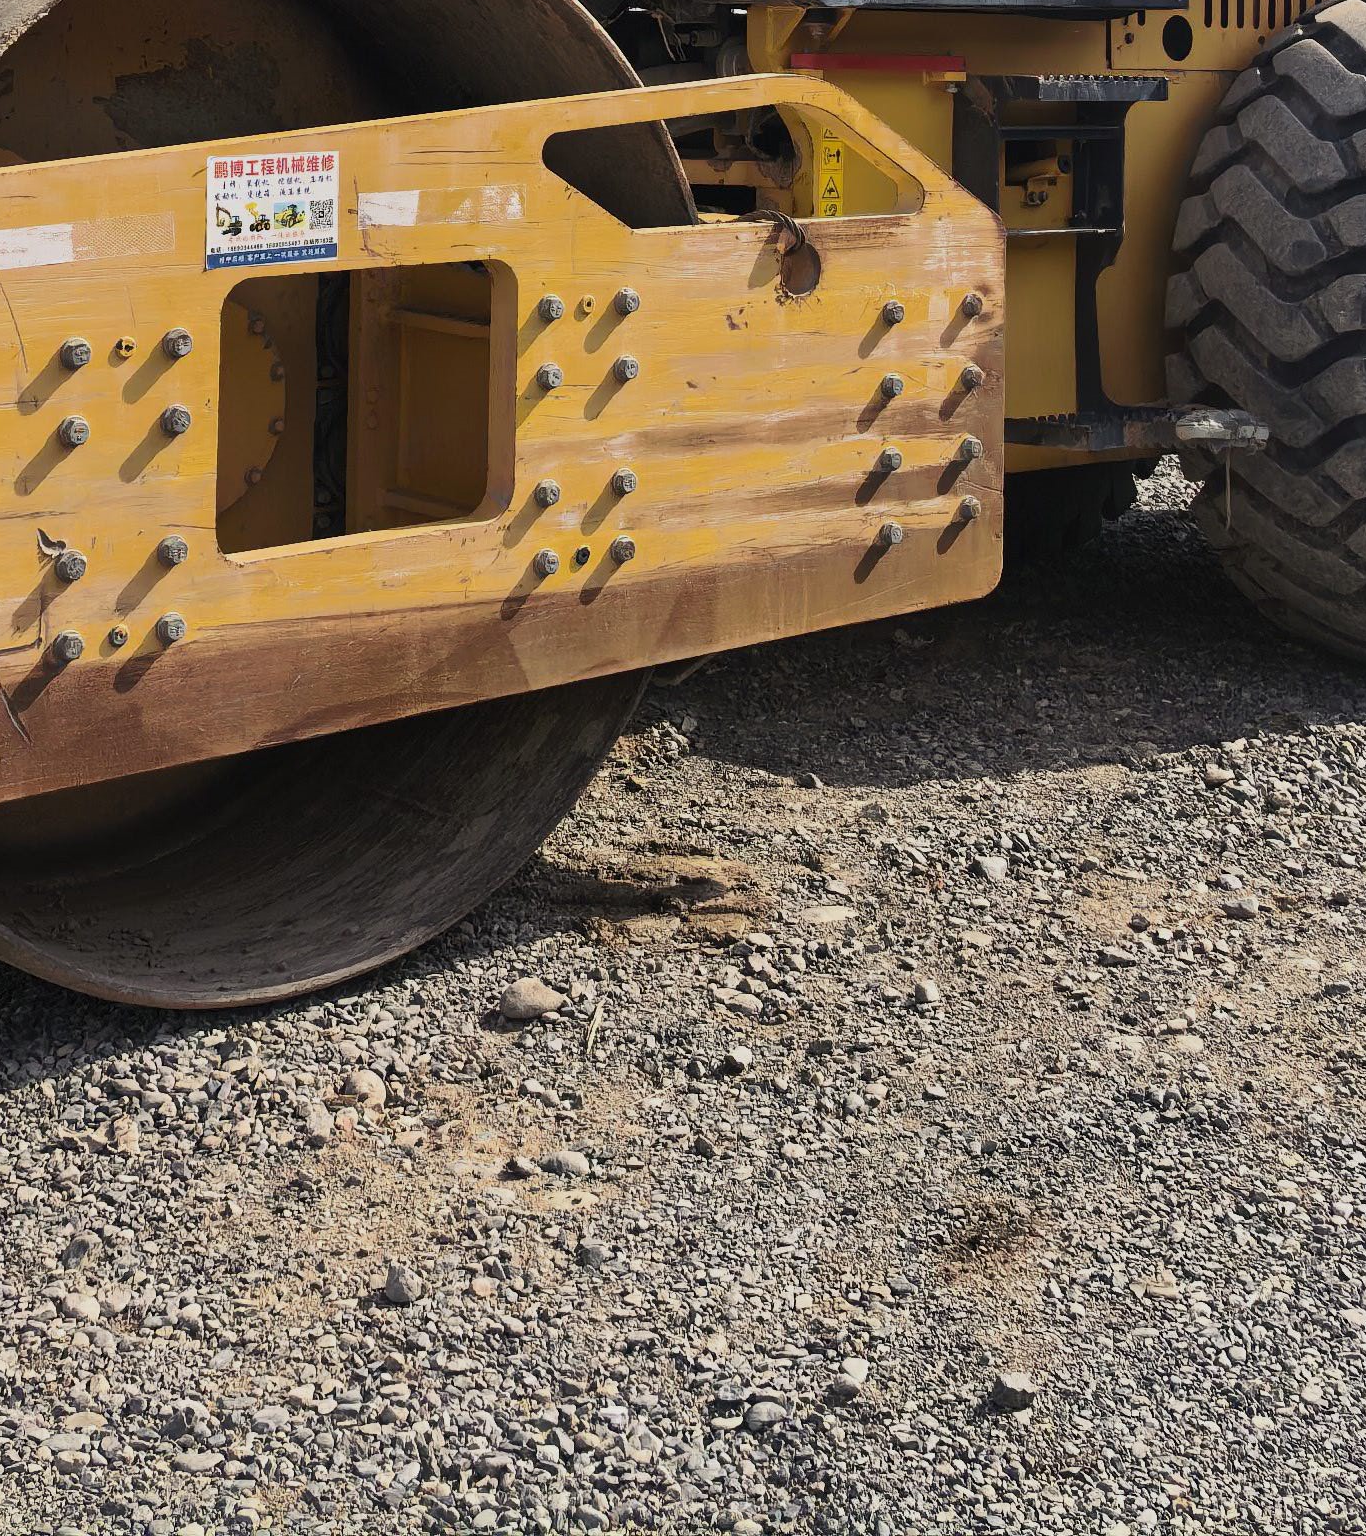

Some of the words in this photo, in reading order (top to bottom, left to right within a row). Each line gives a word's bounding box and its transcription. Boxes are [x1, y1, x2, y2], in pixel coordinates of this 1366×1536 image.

[213, 155, 335, 179] 鹏博工程机械维修
